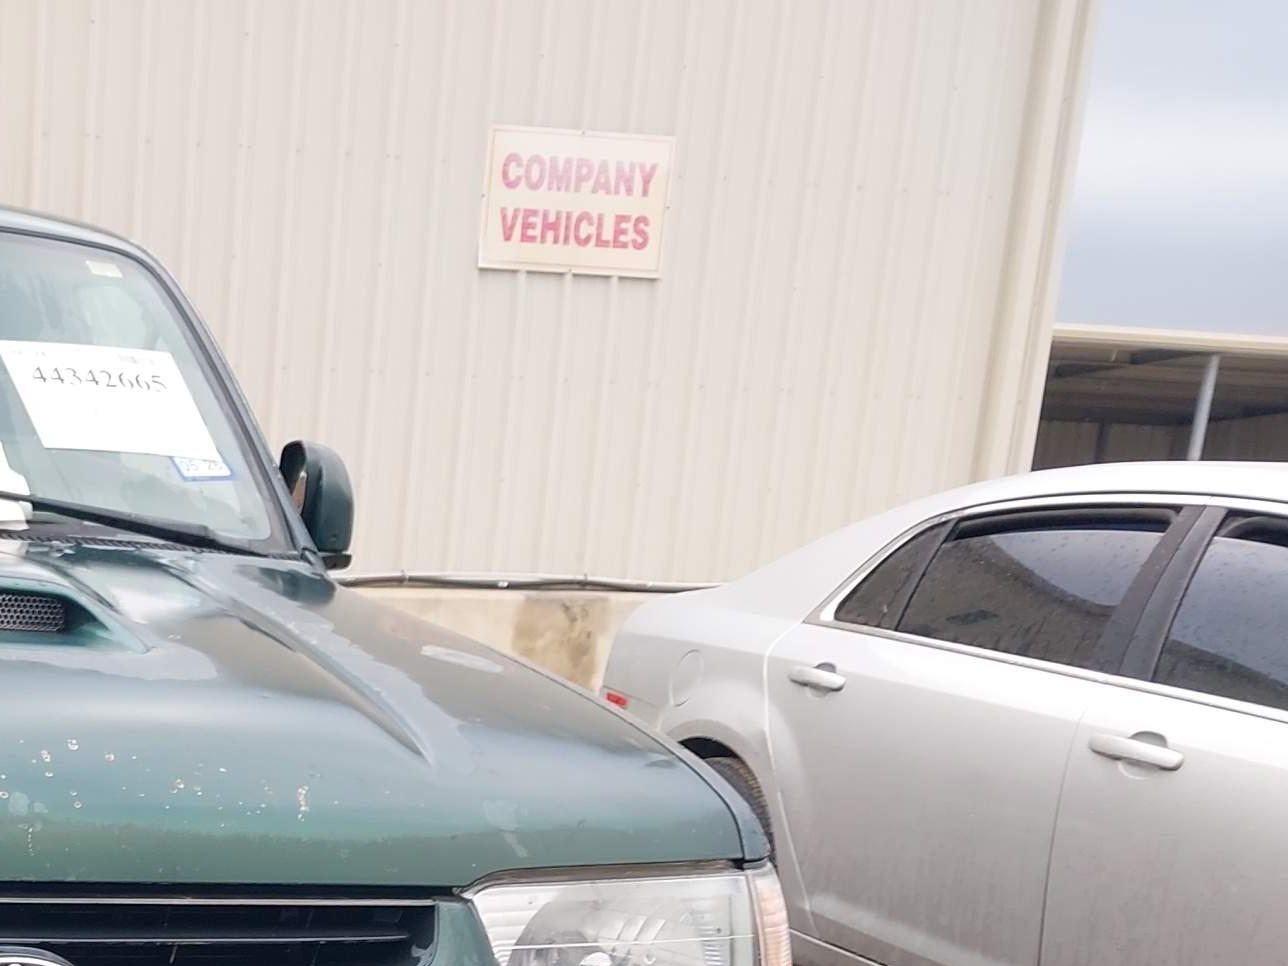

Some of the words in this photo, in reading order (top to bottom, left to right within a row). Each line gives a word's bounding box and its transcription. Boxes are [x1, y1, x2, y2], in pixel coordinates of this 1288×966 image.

[501, 152, 658, 198] COMPANY
[499, 206, 650, 250] VEHICLES
[31, 365, 168, 392] 44342665
